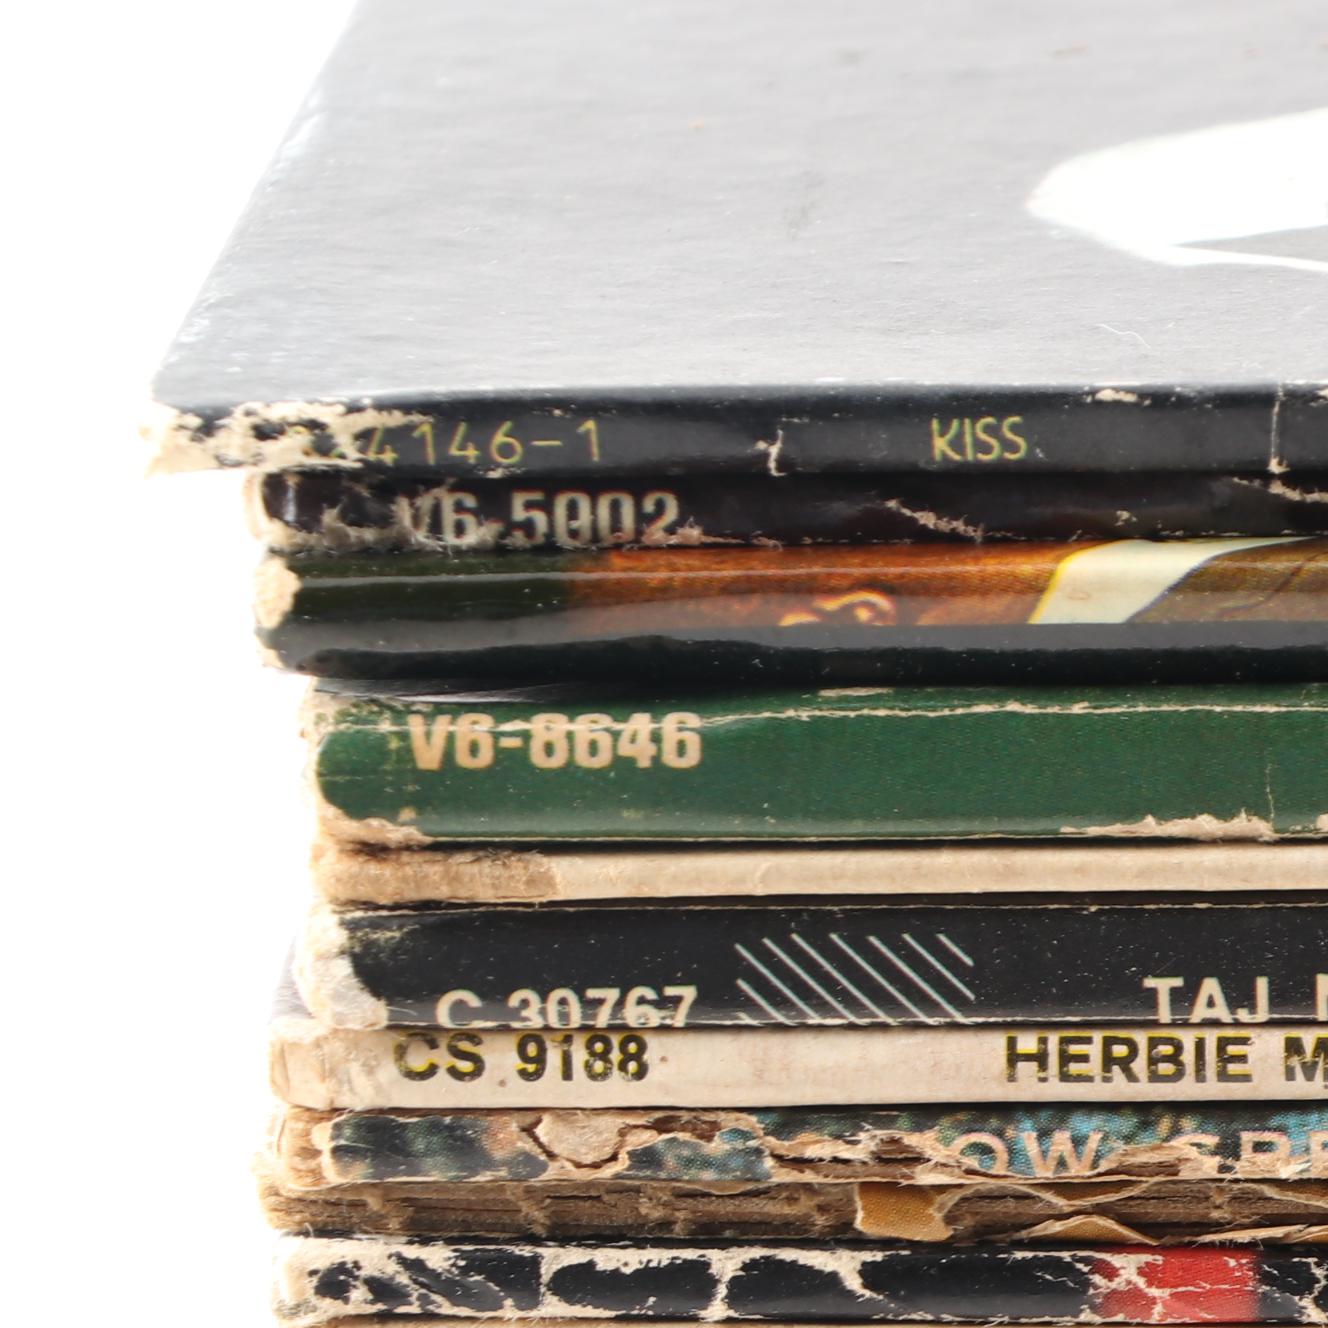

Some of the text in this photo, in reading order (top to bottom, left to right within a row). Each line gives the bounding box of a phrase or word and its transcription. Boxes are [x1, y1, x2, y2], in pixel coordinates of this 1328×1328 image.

[290, 418, 601, 467] 4146-1
[931, 417, 1028, 462] KISS
[408, 711, 704, 771] V6-8646
[435, 984, 699, 1029] C 30767
[1142, 975, 1271, 1024] TAJ
[393, 1033, 650, 1082] CS 9188
[1005, 1034, 1254, 1085] HERBIE
[950, 1130, 1105, 1177] OW
